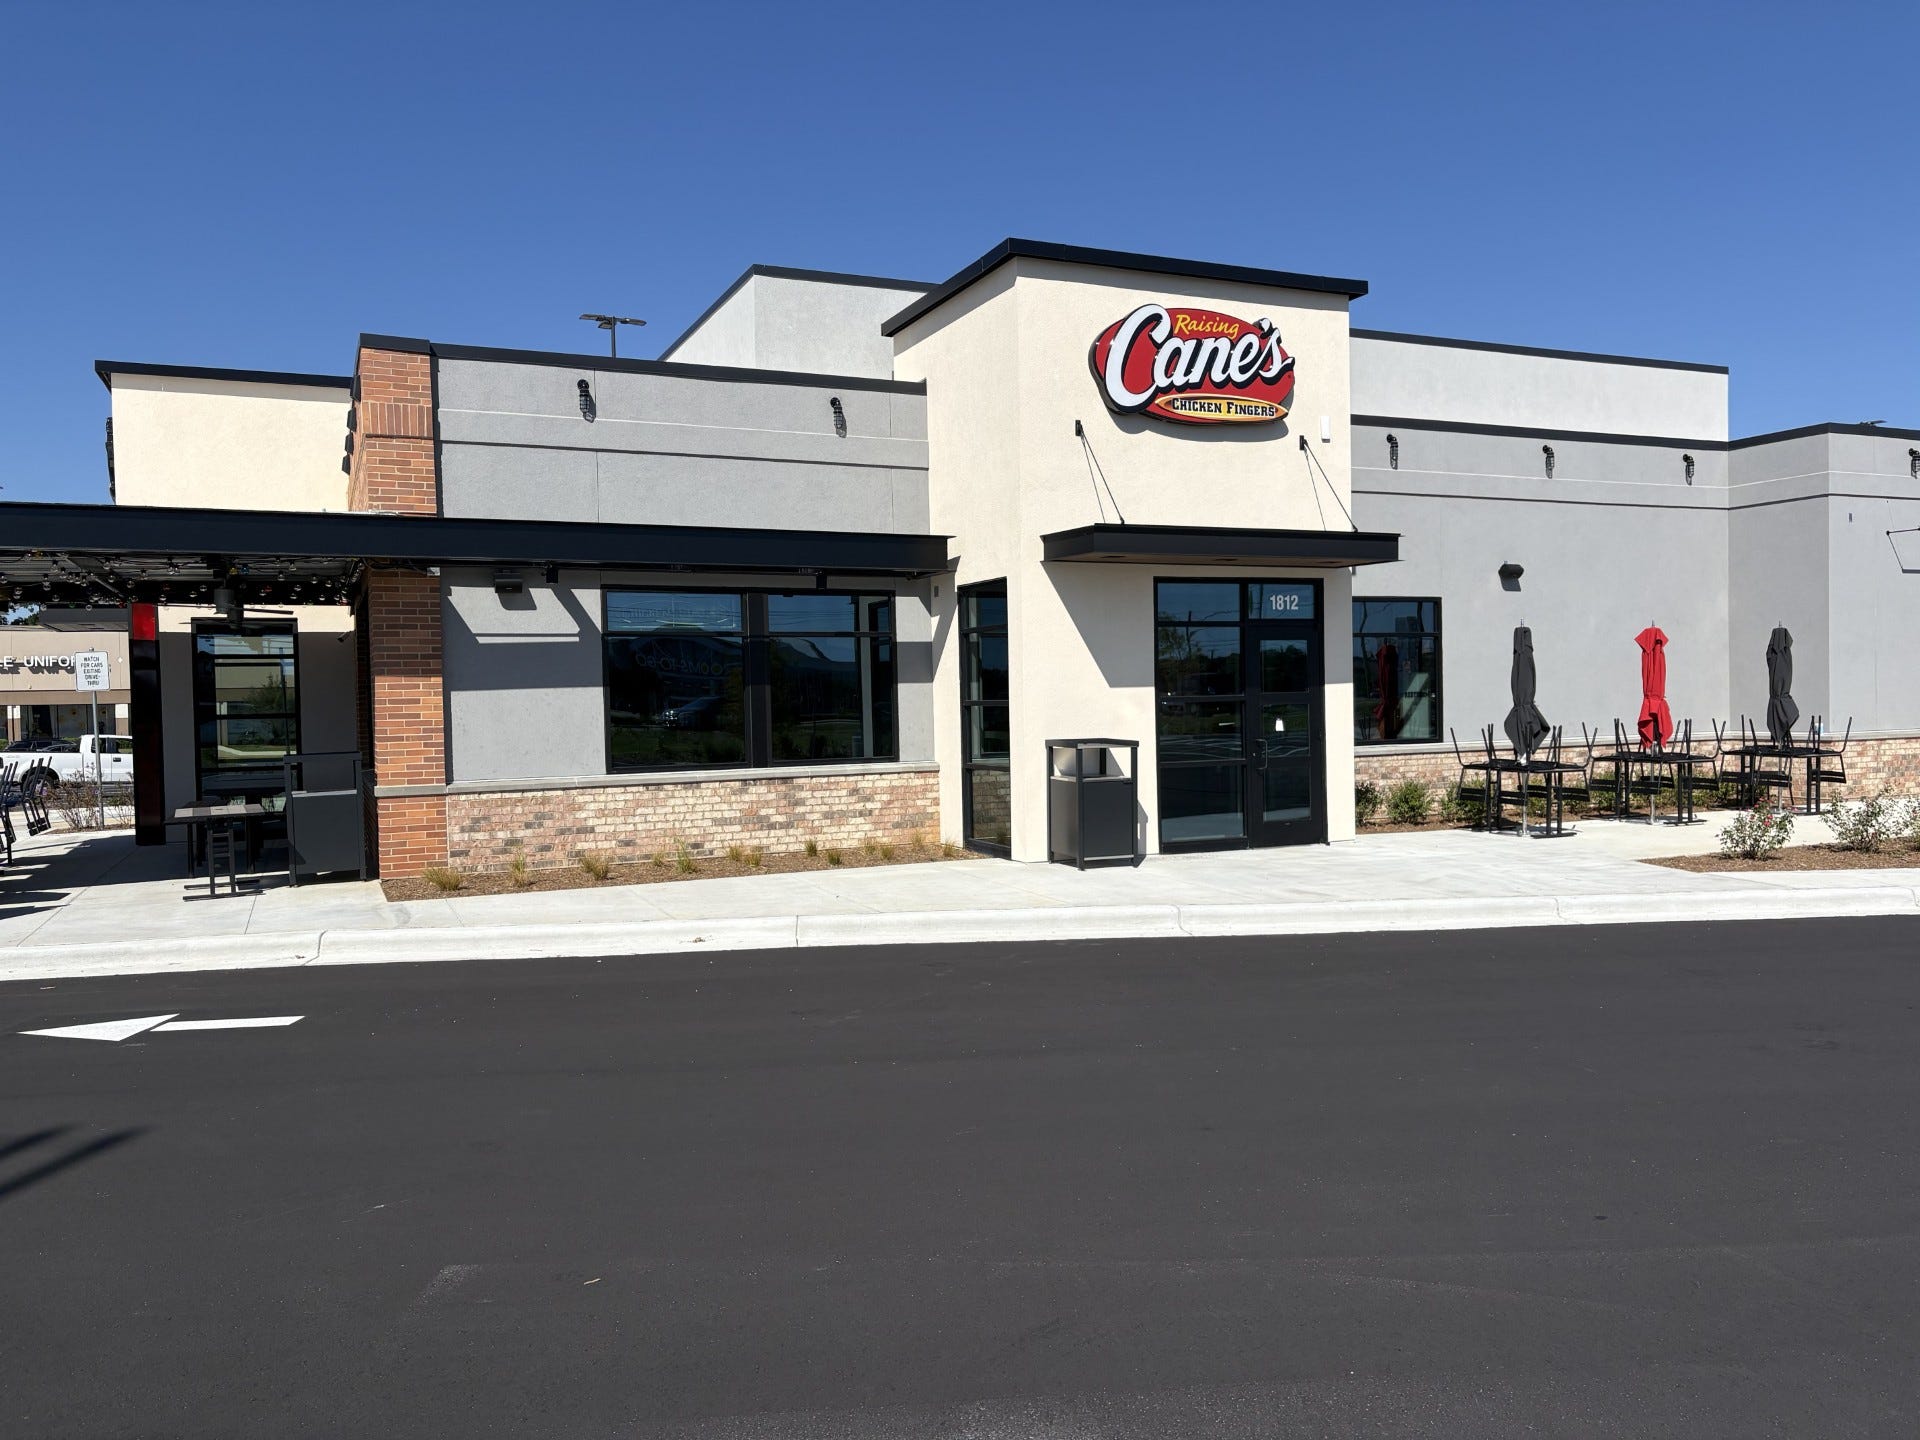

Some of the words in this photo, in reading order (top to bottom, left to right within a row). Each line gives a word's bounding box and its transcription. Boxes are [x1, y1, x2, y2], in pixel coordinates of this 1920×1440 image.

[1174, 314, 1240, 340] Raising
[1104, 303, 1295, 411] Cane's
[1172, 398, 1222, 414] CHICKEN
[1226, 401, 1276, 417] FINGERS
[1270, 595, 1298, 610] 1812
[0, 655, 14, 667] E
